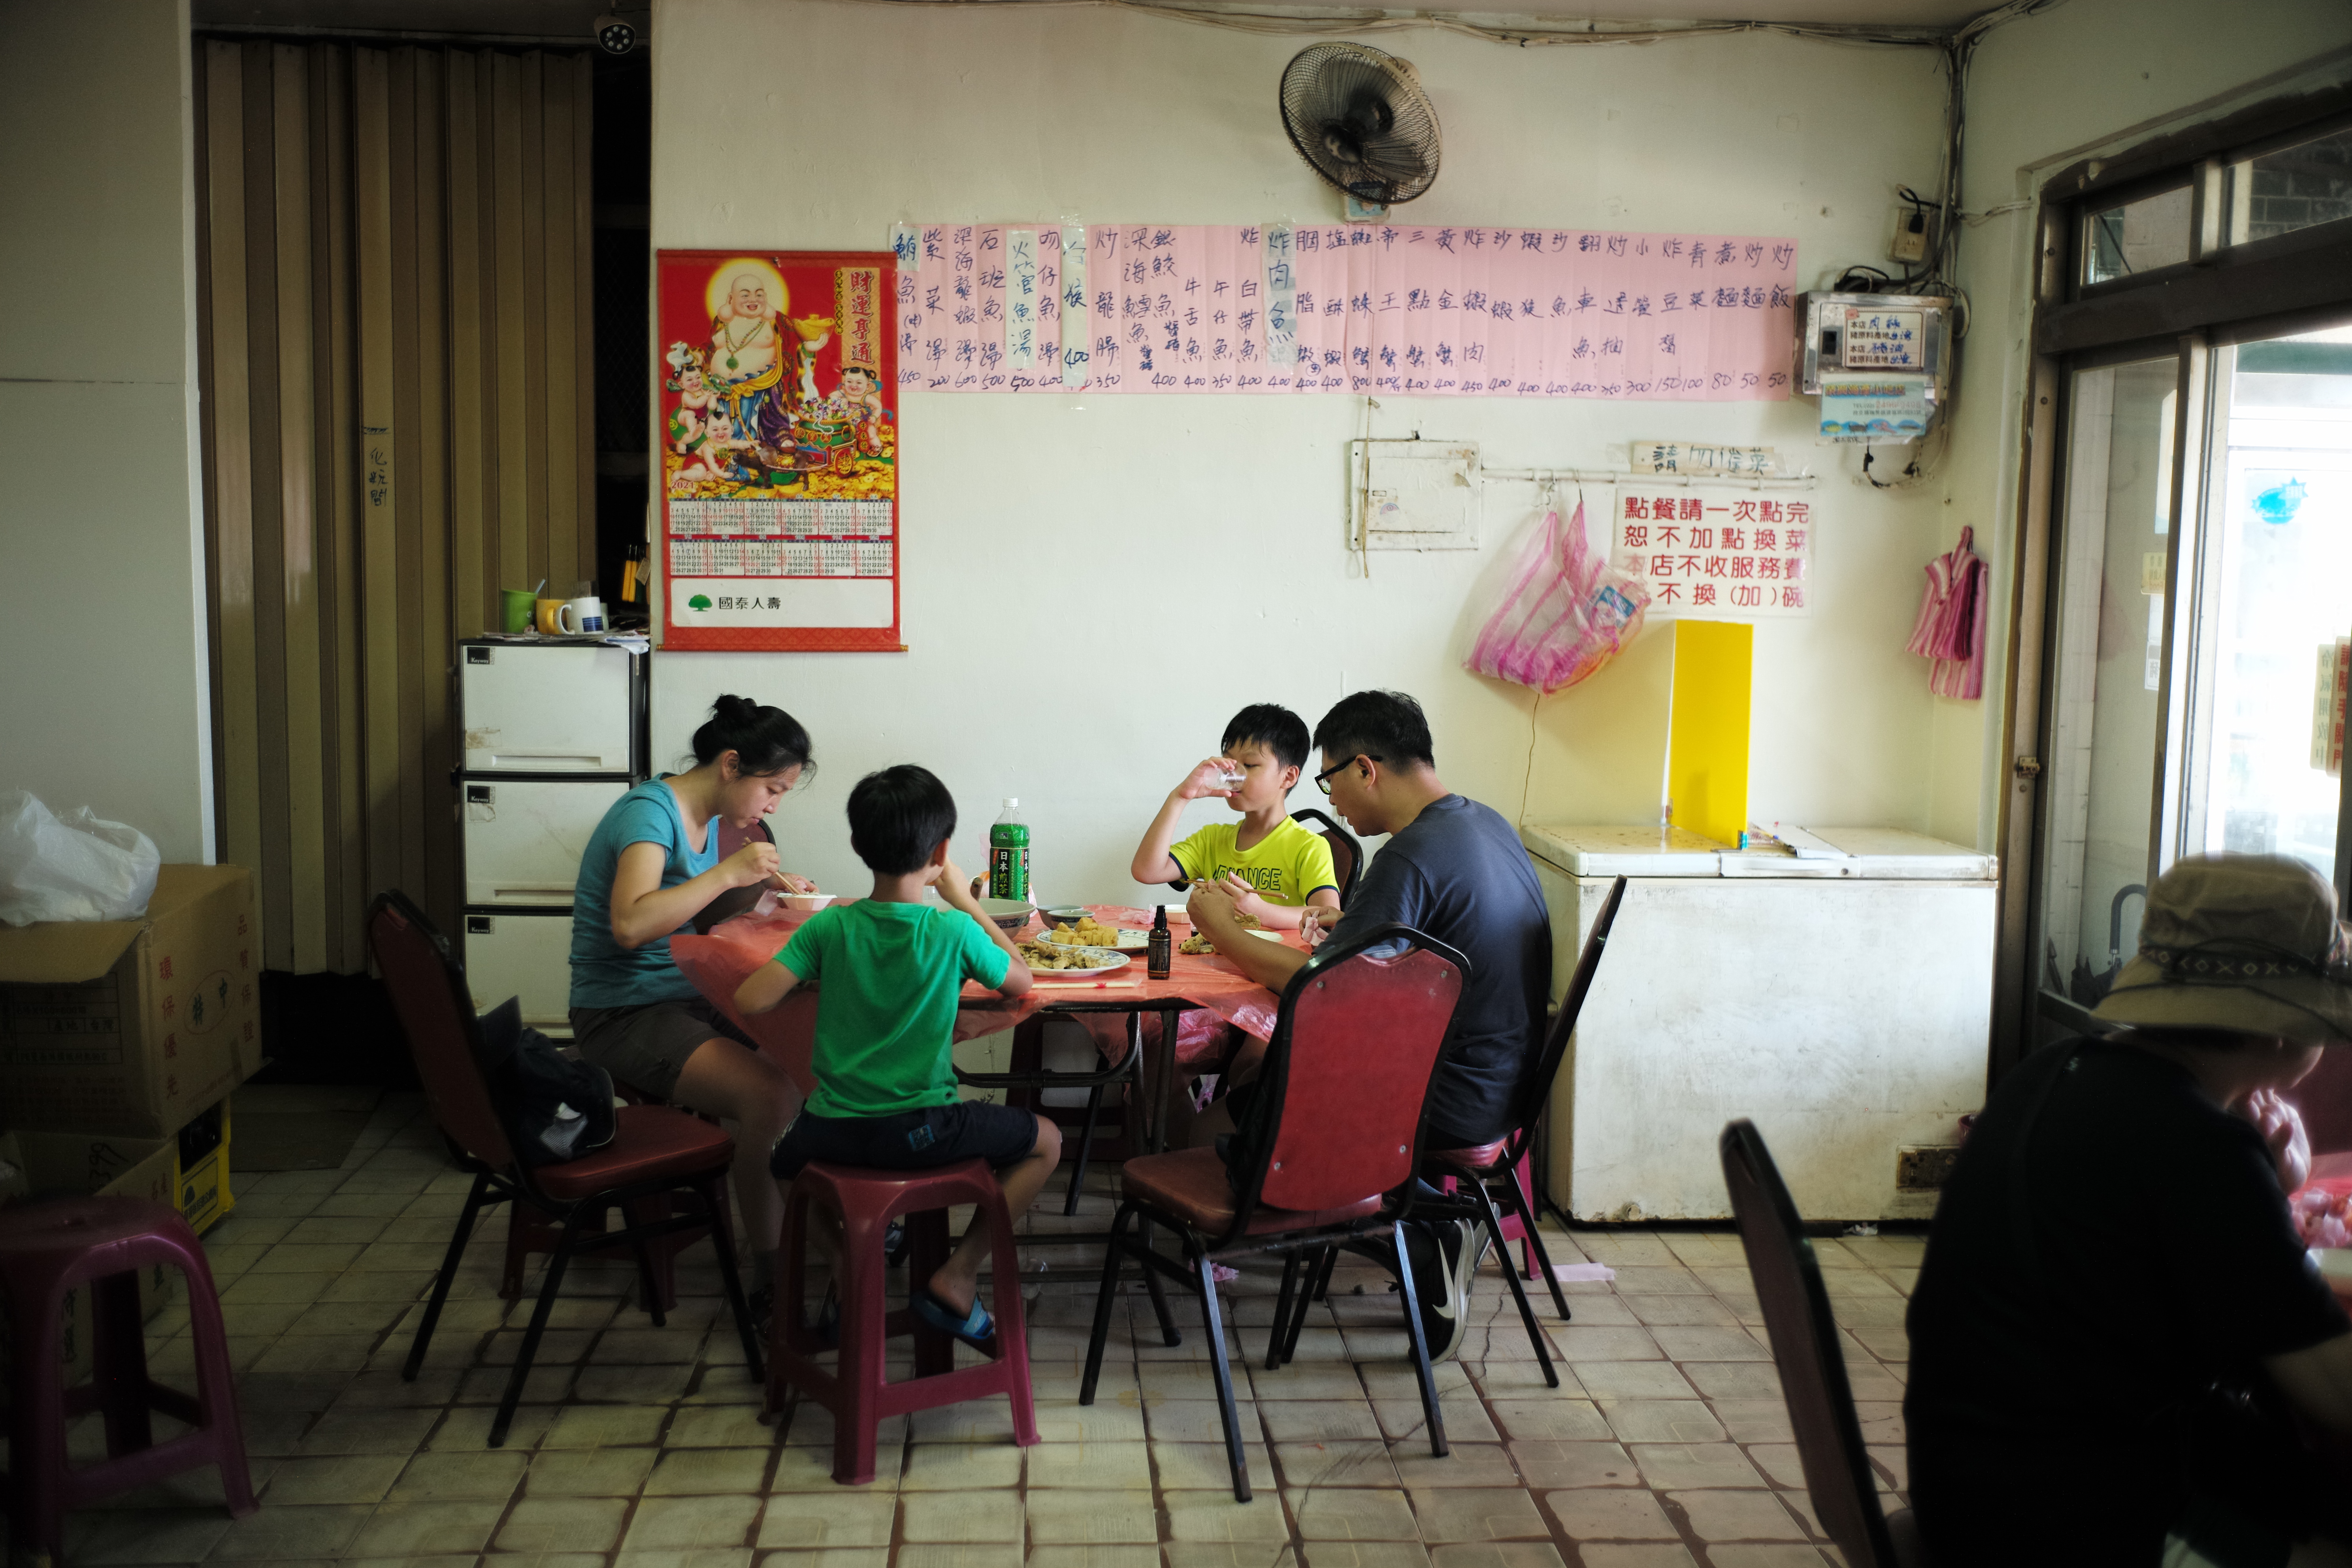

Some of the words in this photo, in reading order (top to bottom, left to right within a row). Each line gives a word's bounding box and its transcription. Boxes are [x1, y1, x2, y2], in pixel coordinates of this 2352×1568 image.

[1689, 241, 1709, 311] 青菜
[1770, 243, 1794, 309] 炒飯
[1237, 228, 1259, 363] 炸白帶魚
[1183, 277, 1202, 364] 牛舌魚
[1064, 348, 1089, 369] 400
[898, 369, 920, 384] 450
[928, 375, 950, 387] 200
[956, 372, 976, 387] 600
[982, 375, 1006, 389] 500
[1011, 376, 1035, 391] 500
[1039, 375, 1062, 386] 400
[1097, 373, 1120, 387] 350
[1152, 373, 1176, 388] 400
[1184, 375, 1205, 386] 400
[1213, 373, 1231, 388] 350
[1238, 375, 1262, 390] 400
[1268, 376, 1290, 387] 400
[1296, 376, 1317, 391] 400
[1321, 375, 1343, 391] 400
[1352, 376, 1371, 390] 800
[1405, 378, 1429, 390] 400
[1434, 378, 1455, 388] 400
[1489, 378, 1511, 390] 400
[1682, 377, 1703, 391] 100
[1712, 373, 1731, 390] 80
[1740, 373, 1758, 388] 50
[1768, 372, 1786, 387] 50
[1461, 380, 1482, 392] 450
[1517, 381, 1540, 395] 400
[1546, 381, 1568, 395] 400
[1571, 382, 1596, 394] 400
[1626, 380, 1651, 394] 300
[1655, 377, 1681, 393] 150
[1653, 446, 1769, 475] 請勿催菜
[1625, 497, 1809, 524] 點餐請一次點完
[1624, 525, 1807, 552] 恕不加點換菜
[1624, 554, 1806, 580] 本店不收服務費
[719, 597, 781, 610] 國泰人壽
[999, 852, 1008, 894] 日本煎茶
[238, 914, 254, 1043] 品質保證
[159, 956, 179, 1100] 環保優先
